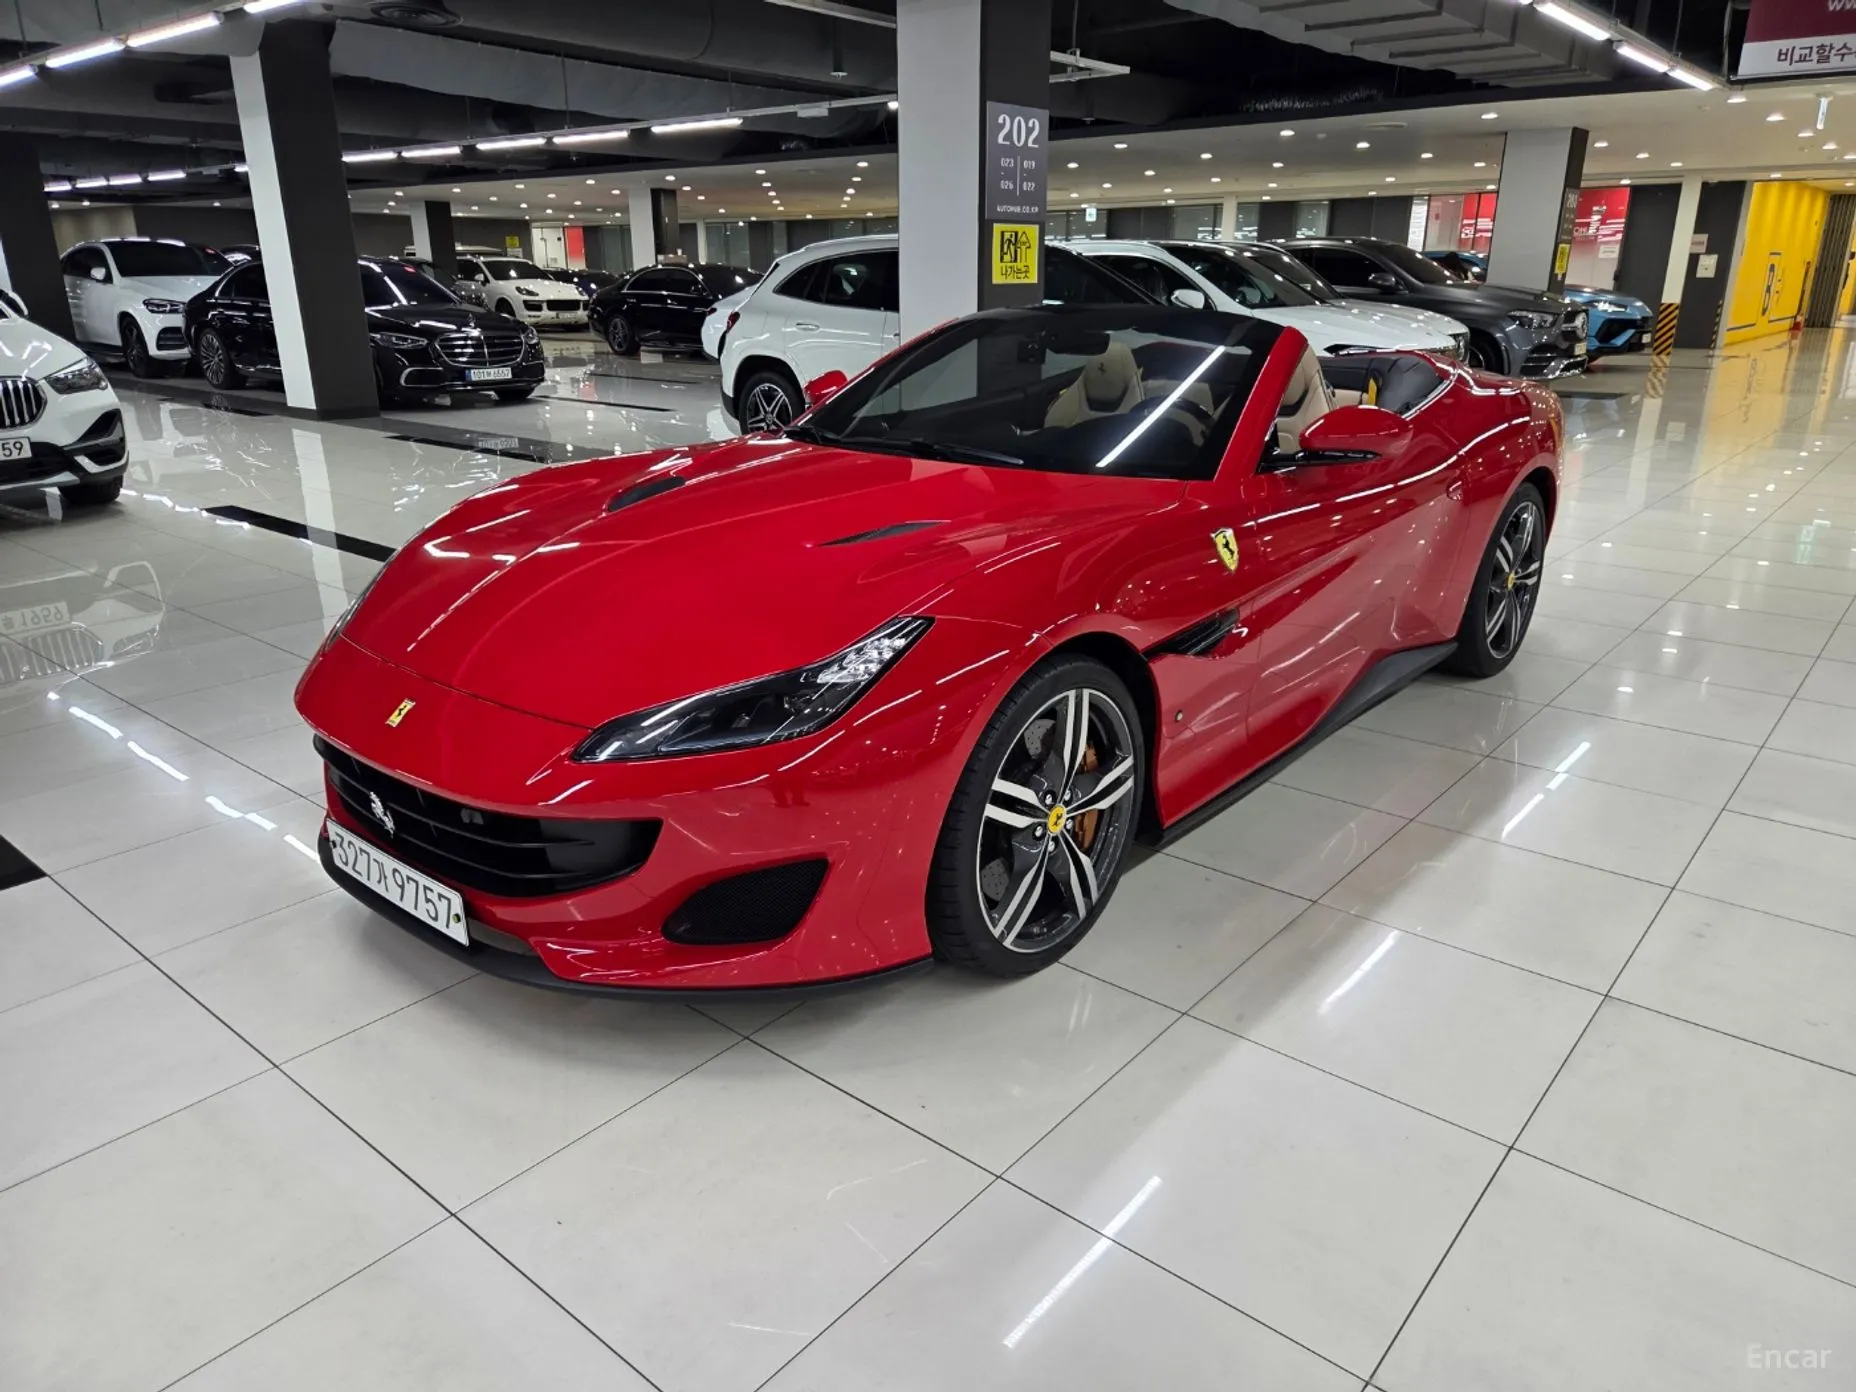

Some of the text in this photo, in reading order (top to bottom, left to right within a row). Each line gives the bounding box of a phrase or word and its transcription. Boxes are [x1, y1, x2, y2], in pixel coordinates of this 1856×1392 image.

[1777, 42, 1856, 66] 비교할수
[998, 114, 1040, 148] 202
[1000, 264, 1030, 280] 나가는곳
